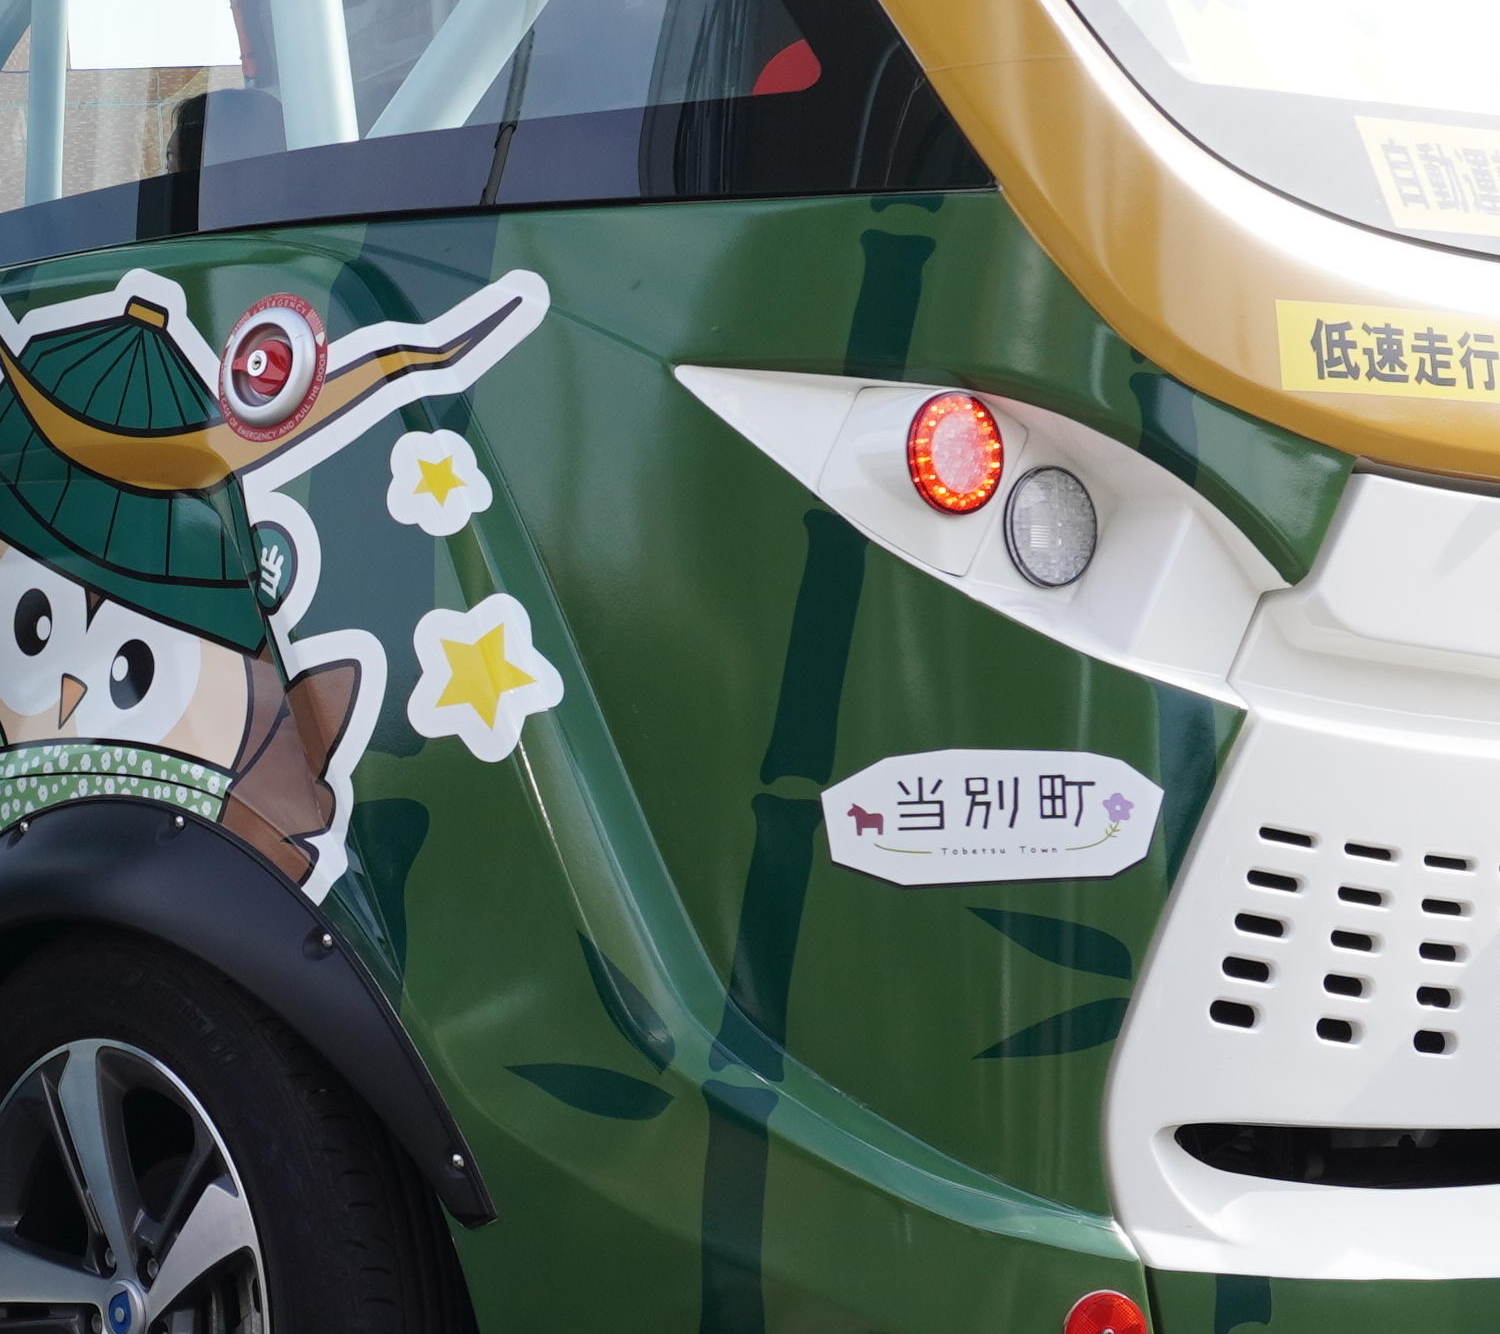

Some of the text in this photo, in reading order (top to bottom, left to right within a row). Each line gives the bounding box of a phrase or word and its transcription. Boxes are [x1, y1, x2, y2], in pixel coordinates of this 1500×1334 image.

[897, 774, 1096, 830] 当別町
[1018, 845, 1059, 854] Town
